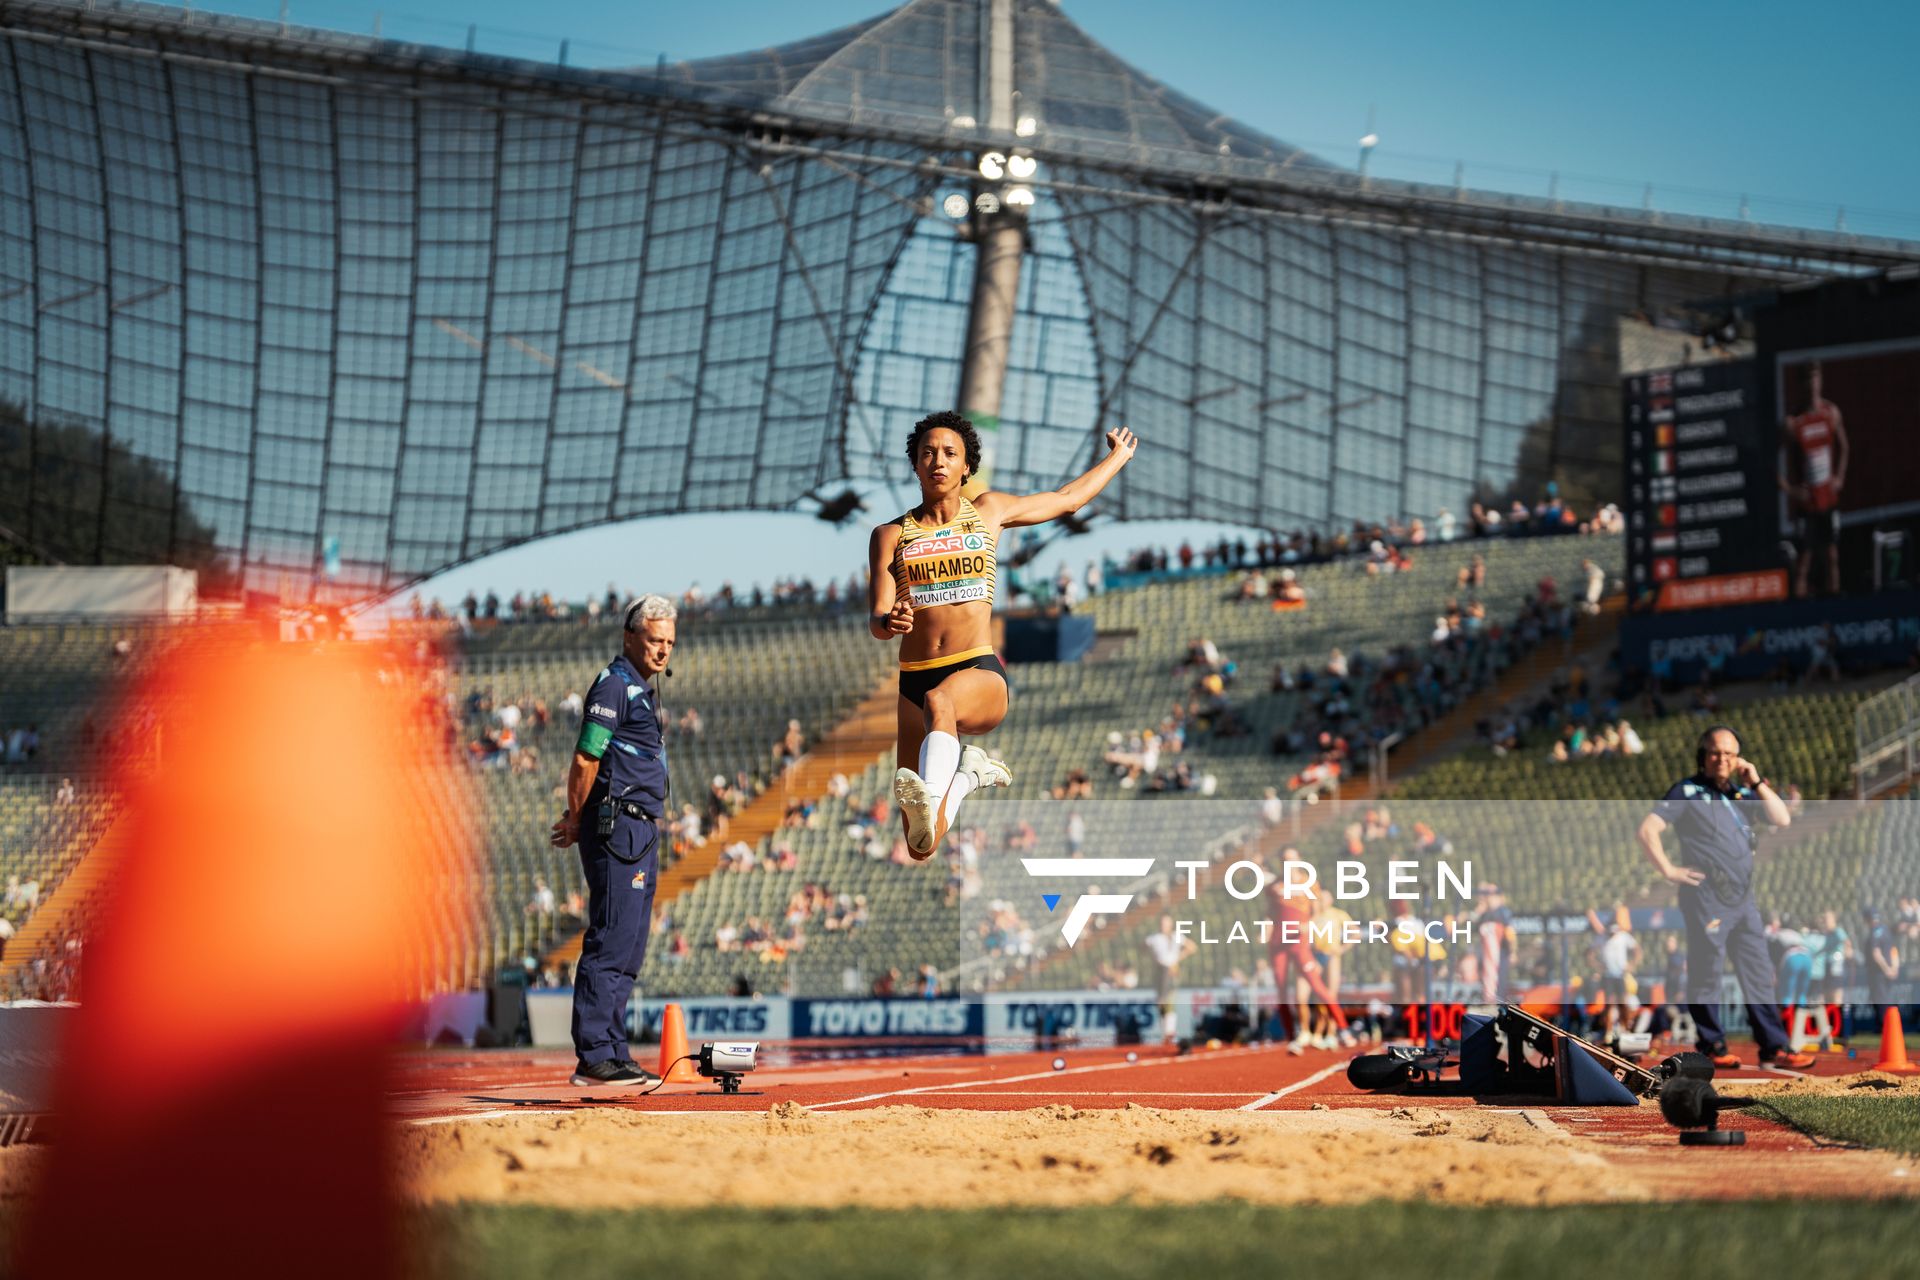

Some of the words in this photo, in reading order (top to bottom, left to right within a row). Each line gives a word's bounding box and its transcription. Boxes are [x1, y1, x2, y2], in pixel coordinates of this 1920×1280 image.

[905, 538, 962, 555] SPAR
[908, 556, 984, 581] MIHAMBO
[915, 590, 957, 604] MUNICH
[960, 587, 984, 599] 2022
[947, 580, 969, 588] CLEAN
[1764, 618, 1893, 653] CHAMPNSHIPS
[689, 1005, 768, 1032] TIRES
[809, 1001, 885, 1034] TOYO
[887, 1000, 969, 1034] TIRES
[1083, 1000, 1155, 1029] TIRS
